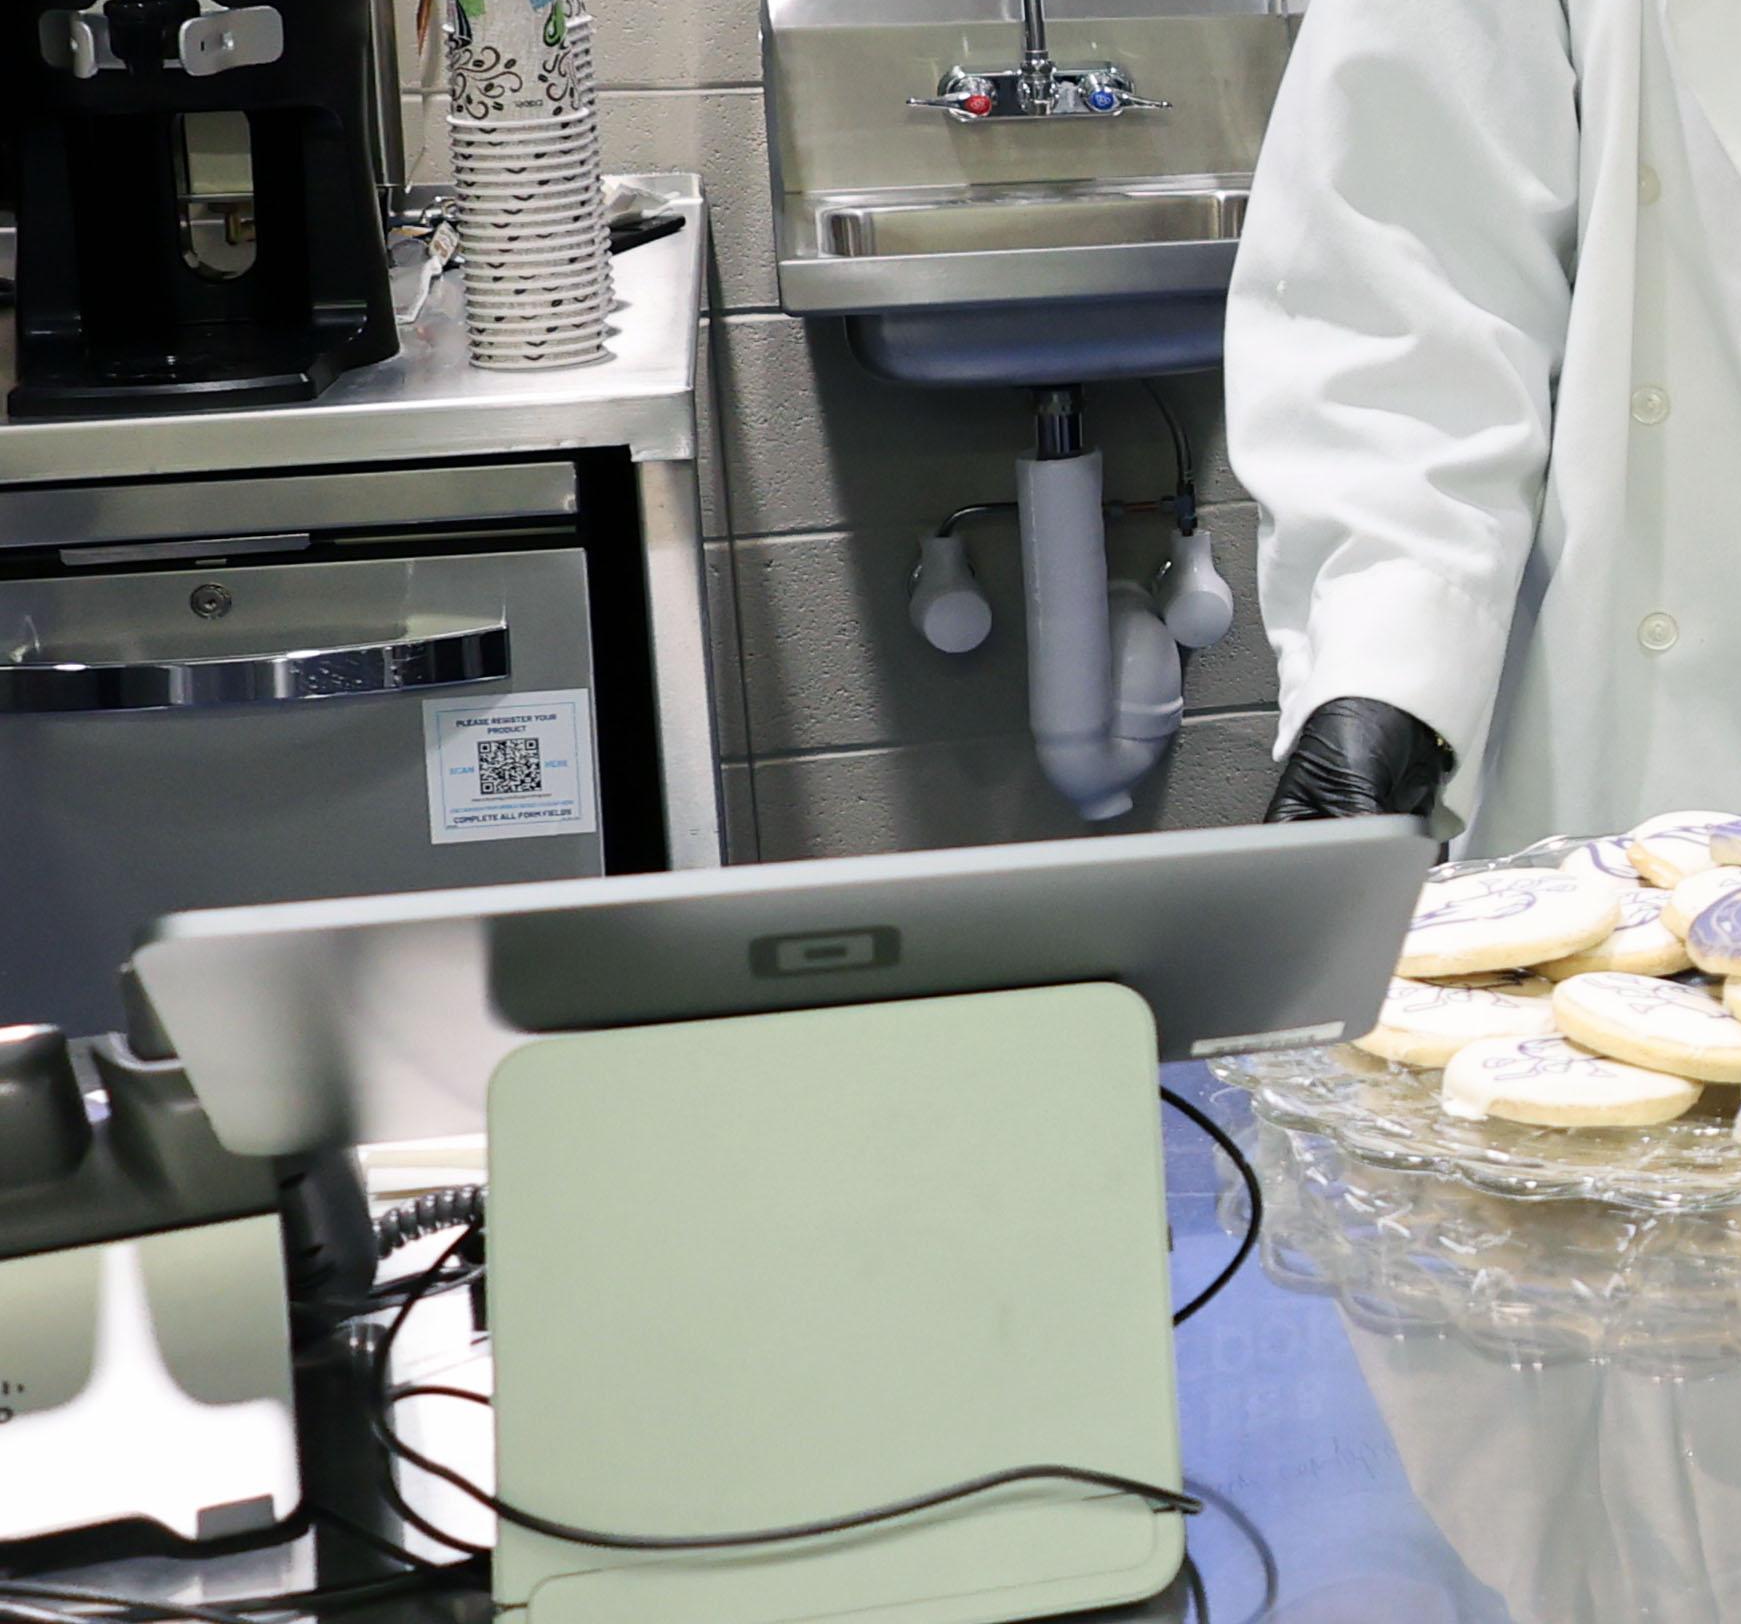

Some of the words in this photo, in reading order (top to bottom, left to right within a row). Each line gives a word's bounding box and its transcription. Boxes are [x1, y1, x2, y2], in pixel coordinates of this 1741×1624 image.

[455, 717, 489, 727] PLEASE
[491, 715, 533, 725] REGISTER
[534, 713, 557, 721] YOUR
[487, 725, 526, 735] PRODUCT
[453, 813, 498, 824] COMPLETE
[500, 811, 516, 820] ALL
[517, 810, 541, 820] FORM
